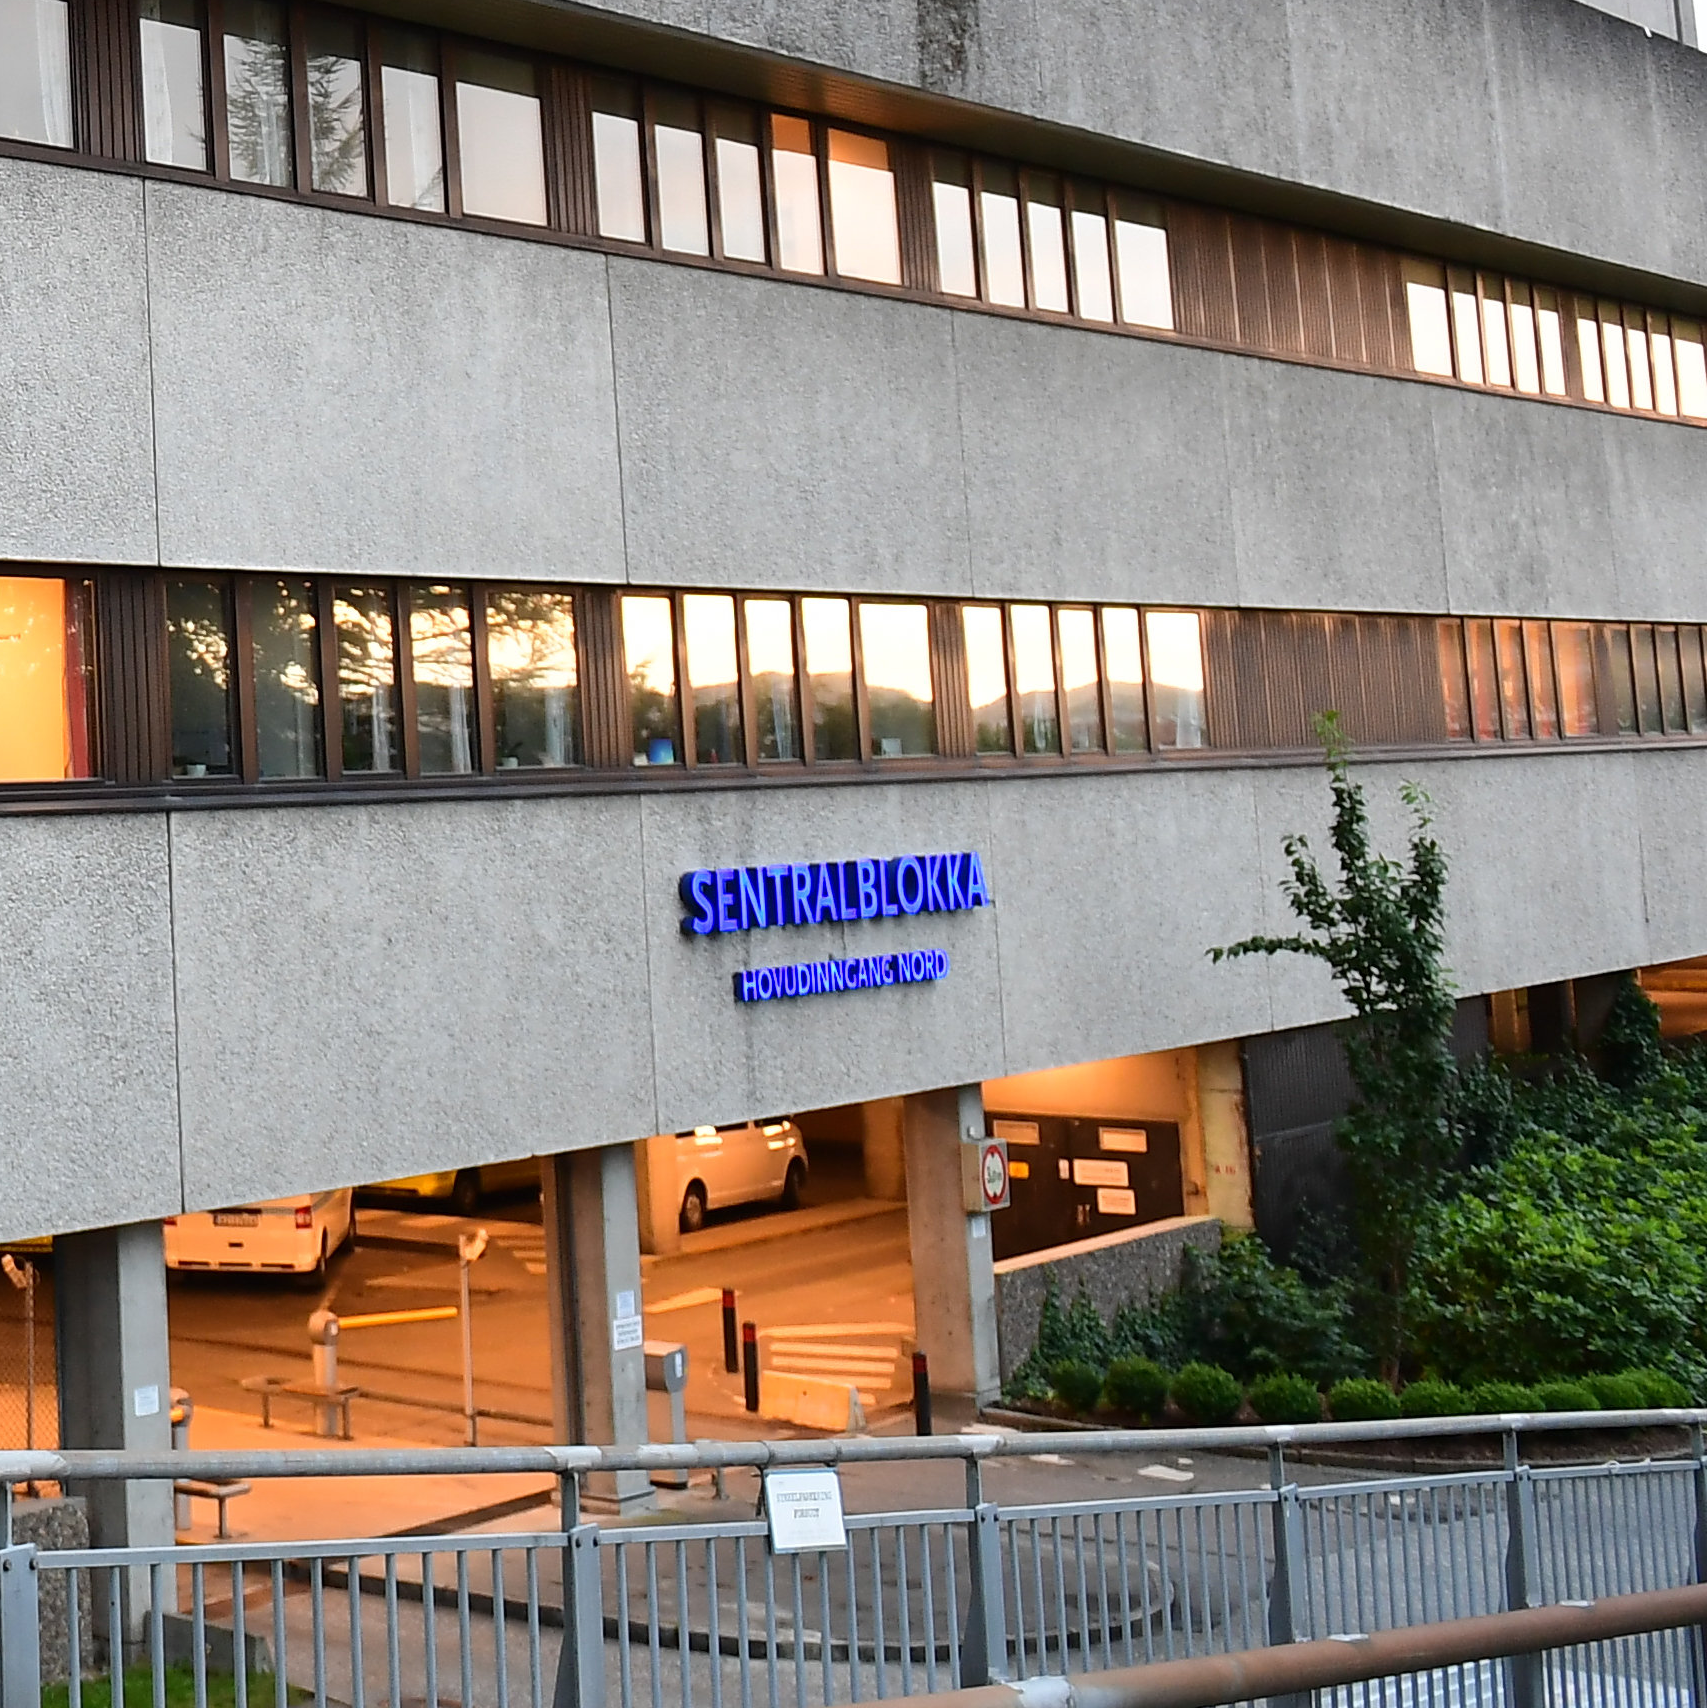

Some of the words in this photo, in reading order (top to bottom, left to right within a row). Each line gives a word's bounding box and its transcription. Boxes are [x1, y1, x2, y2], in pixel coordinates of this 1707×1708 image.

[690, 850, 990, 935] SENTRALBLOKKA
[741, 955, 895, 1002] HOVUDINNGANG
[896, 948, 951, 984] NORD
